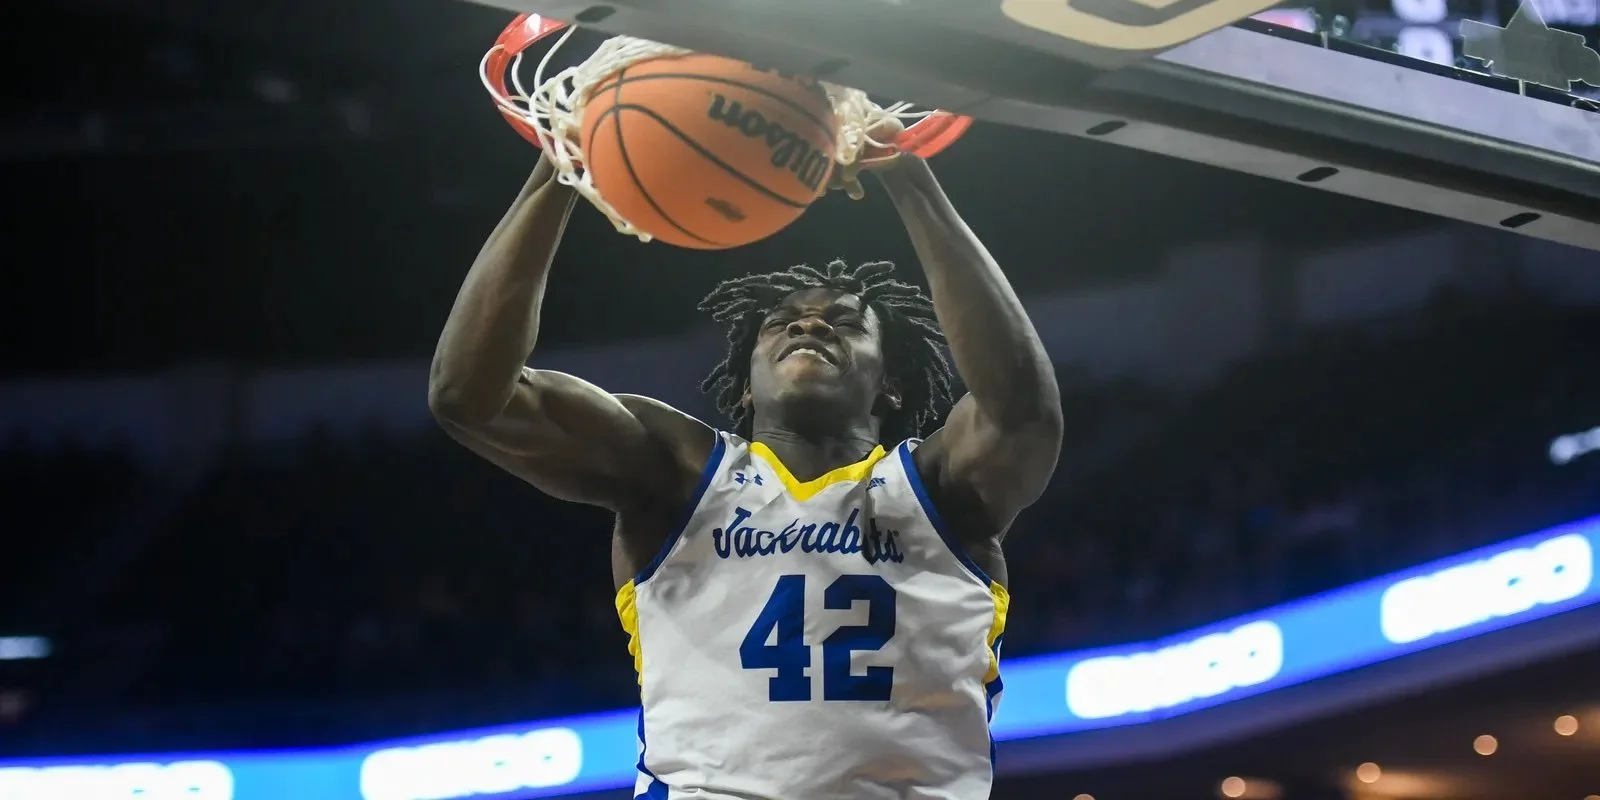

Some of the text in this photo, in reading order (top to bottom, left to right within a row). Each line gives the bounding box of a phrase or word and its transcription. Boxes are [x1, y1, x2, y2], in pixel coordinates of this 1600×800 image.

[709, 94, 829, 192] Wilson
[712, 506, 904, 566] Jackrabts
[739, 574, 897, 702] 42
